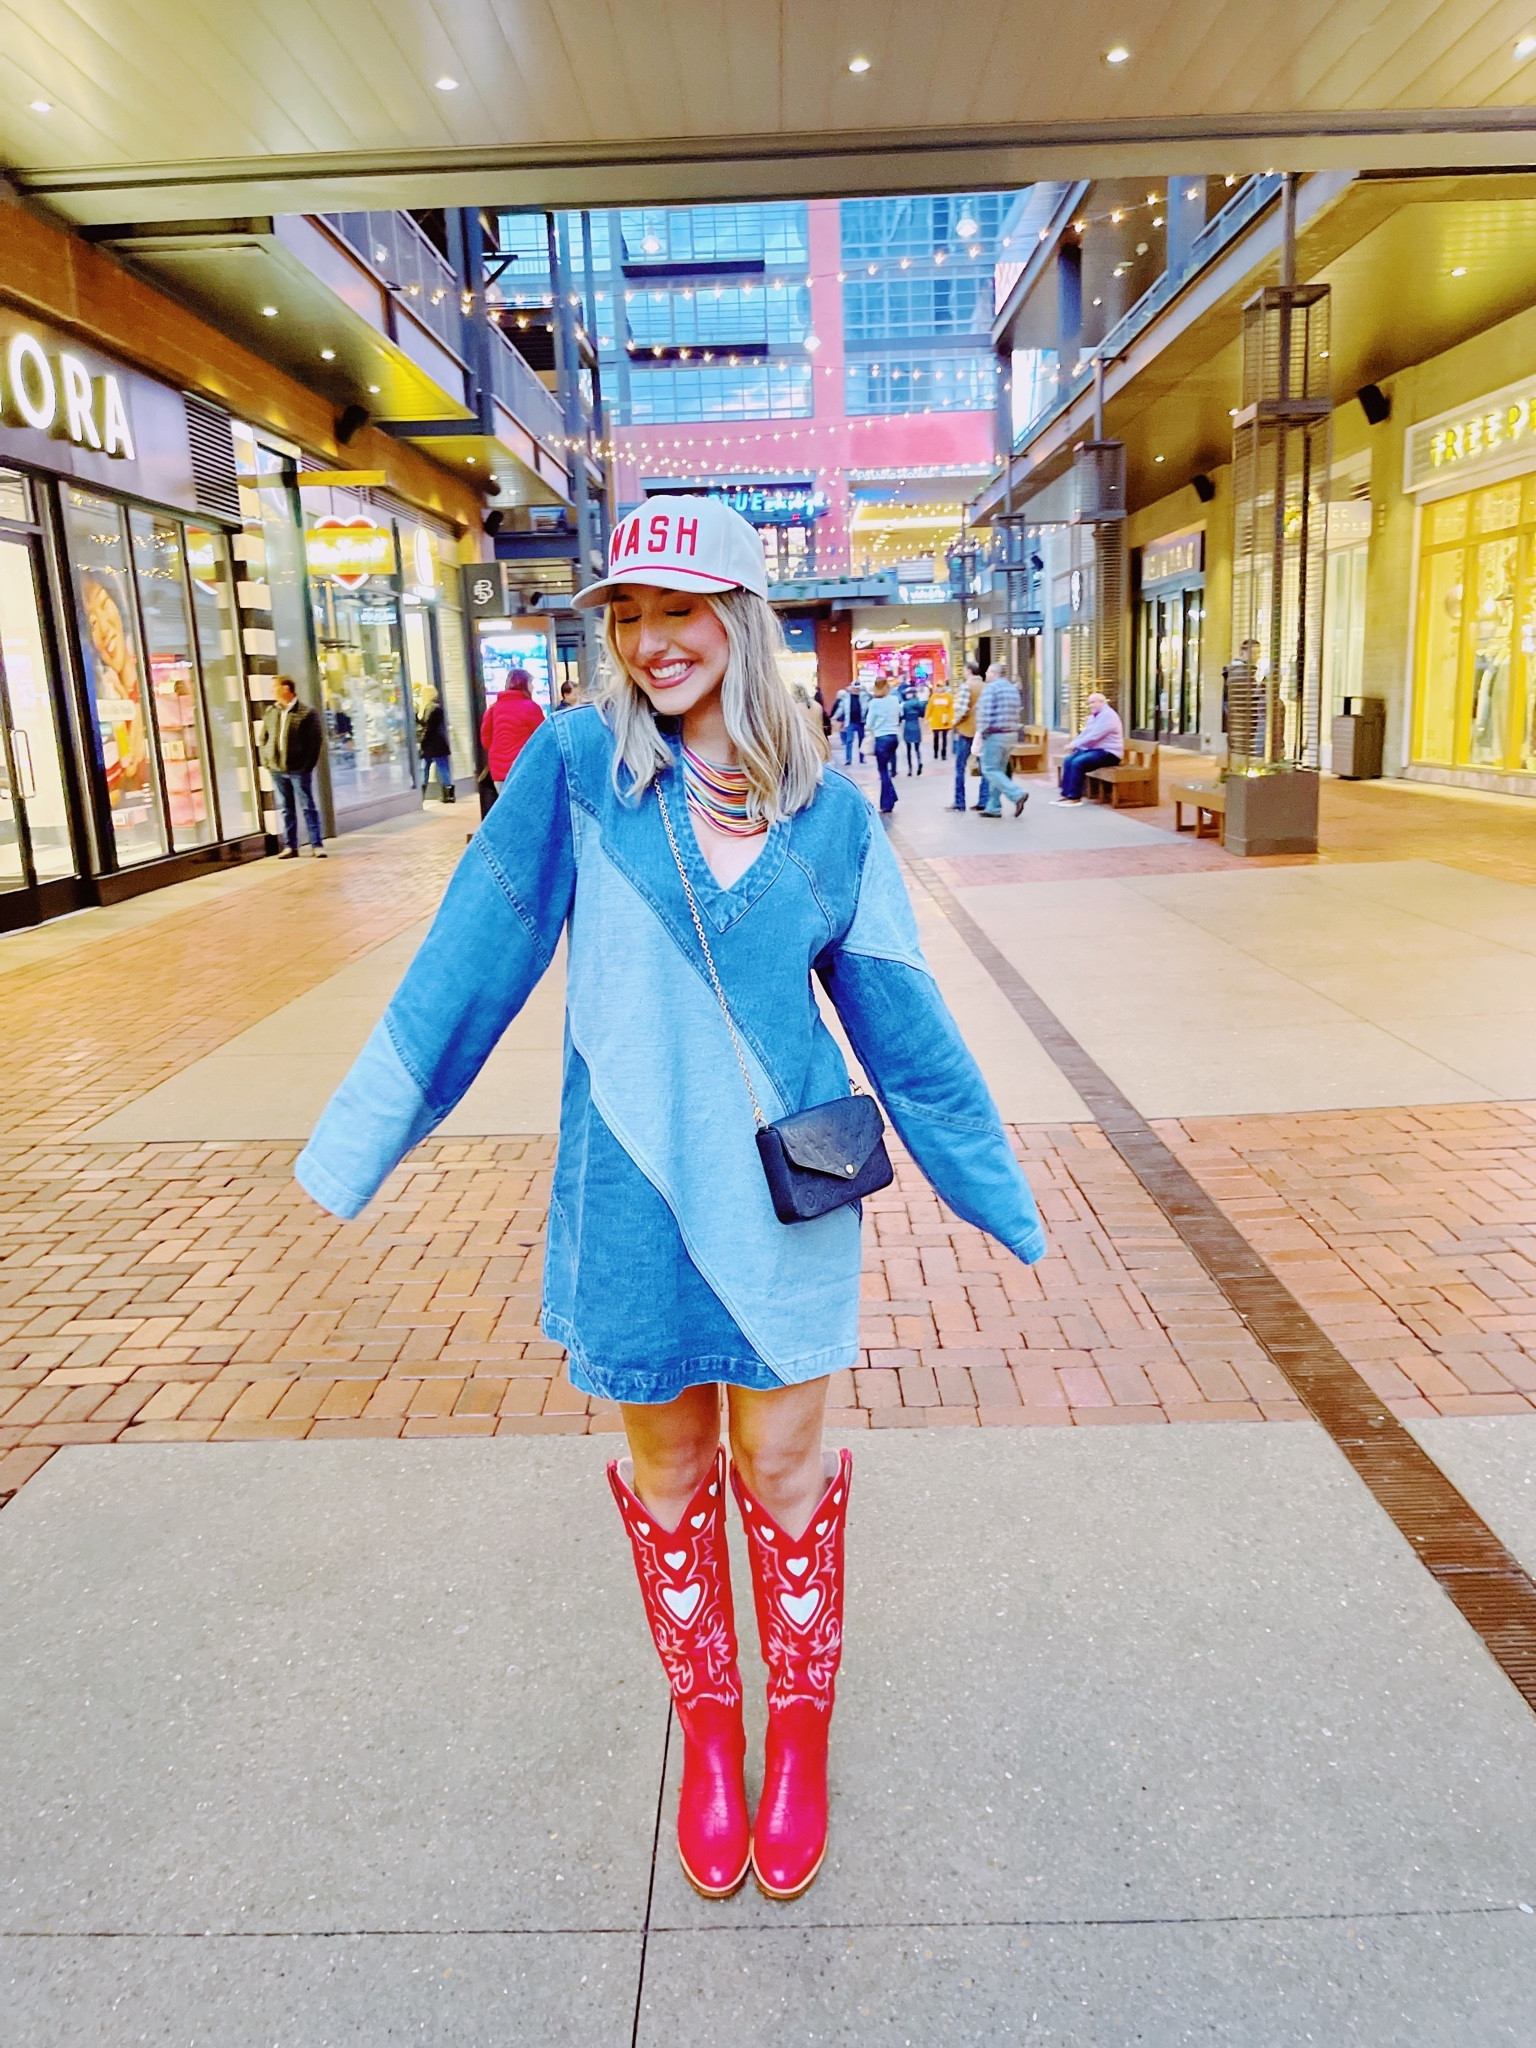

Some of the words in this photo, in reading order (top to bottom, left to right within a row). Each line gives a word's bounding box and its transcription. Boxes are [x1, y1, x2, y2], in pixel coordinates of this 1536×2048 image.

[0, 333, 136, 461] ORA
[1430, 411, 1501, 467] FREE
[610, 515, 698, 566] NASH
